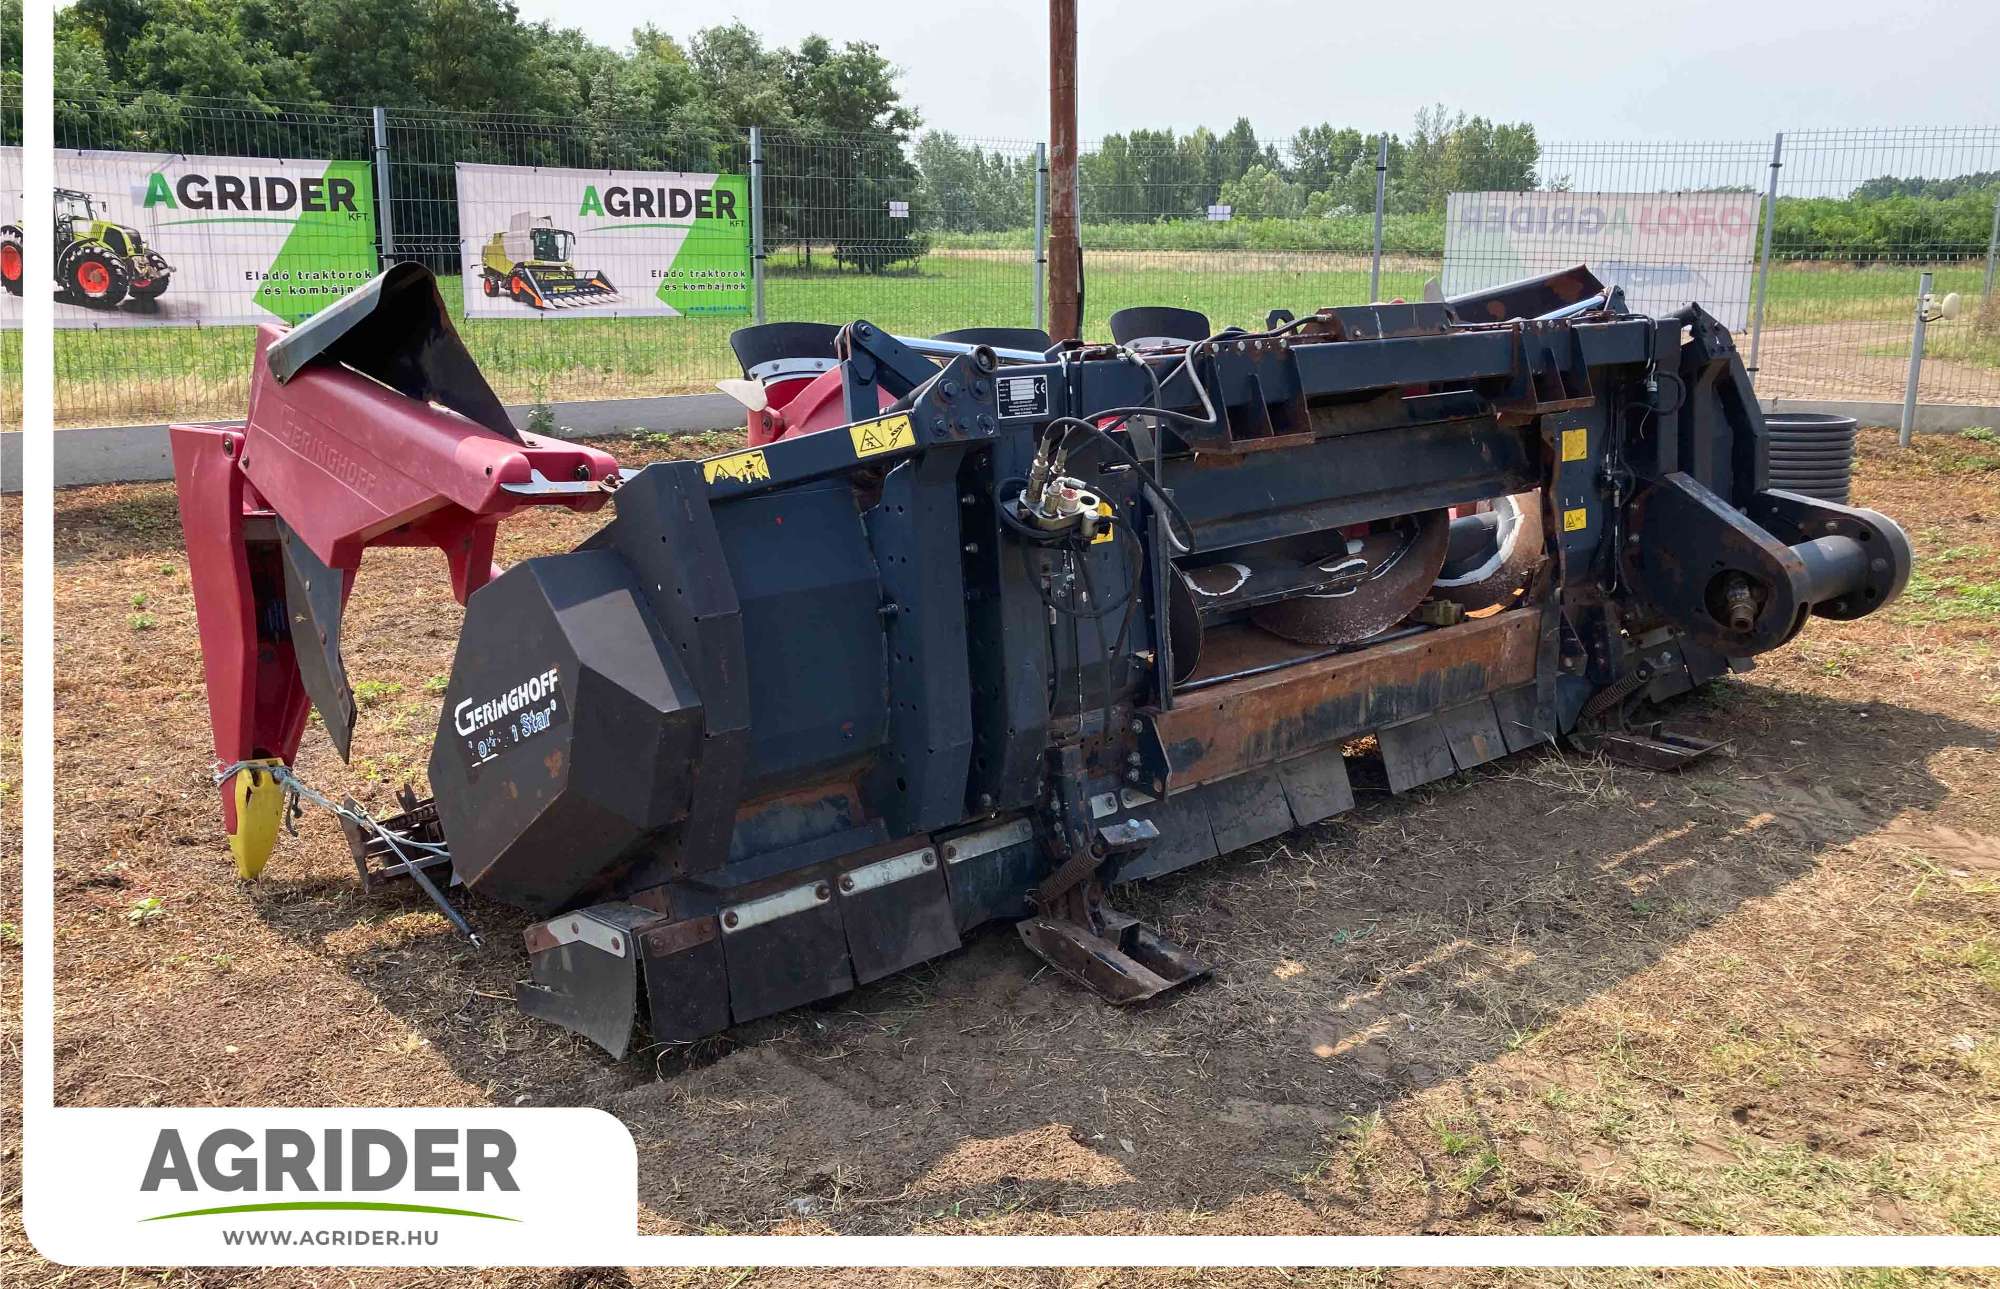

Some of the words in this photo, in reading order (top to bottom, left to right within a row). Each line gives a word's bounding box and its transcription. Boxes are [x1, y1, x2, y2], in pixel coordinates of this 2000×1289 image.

[143, 172, 358, 212] AGRIDER
[578, 185, 736, 220] AGRIDER
[298, 270, 372, 280] traktorok
[690, 269, 746, 278] traktorok
[289, 284, 354, 295] kombájn
[454, 668, 559, 737] GERINGHOFF
